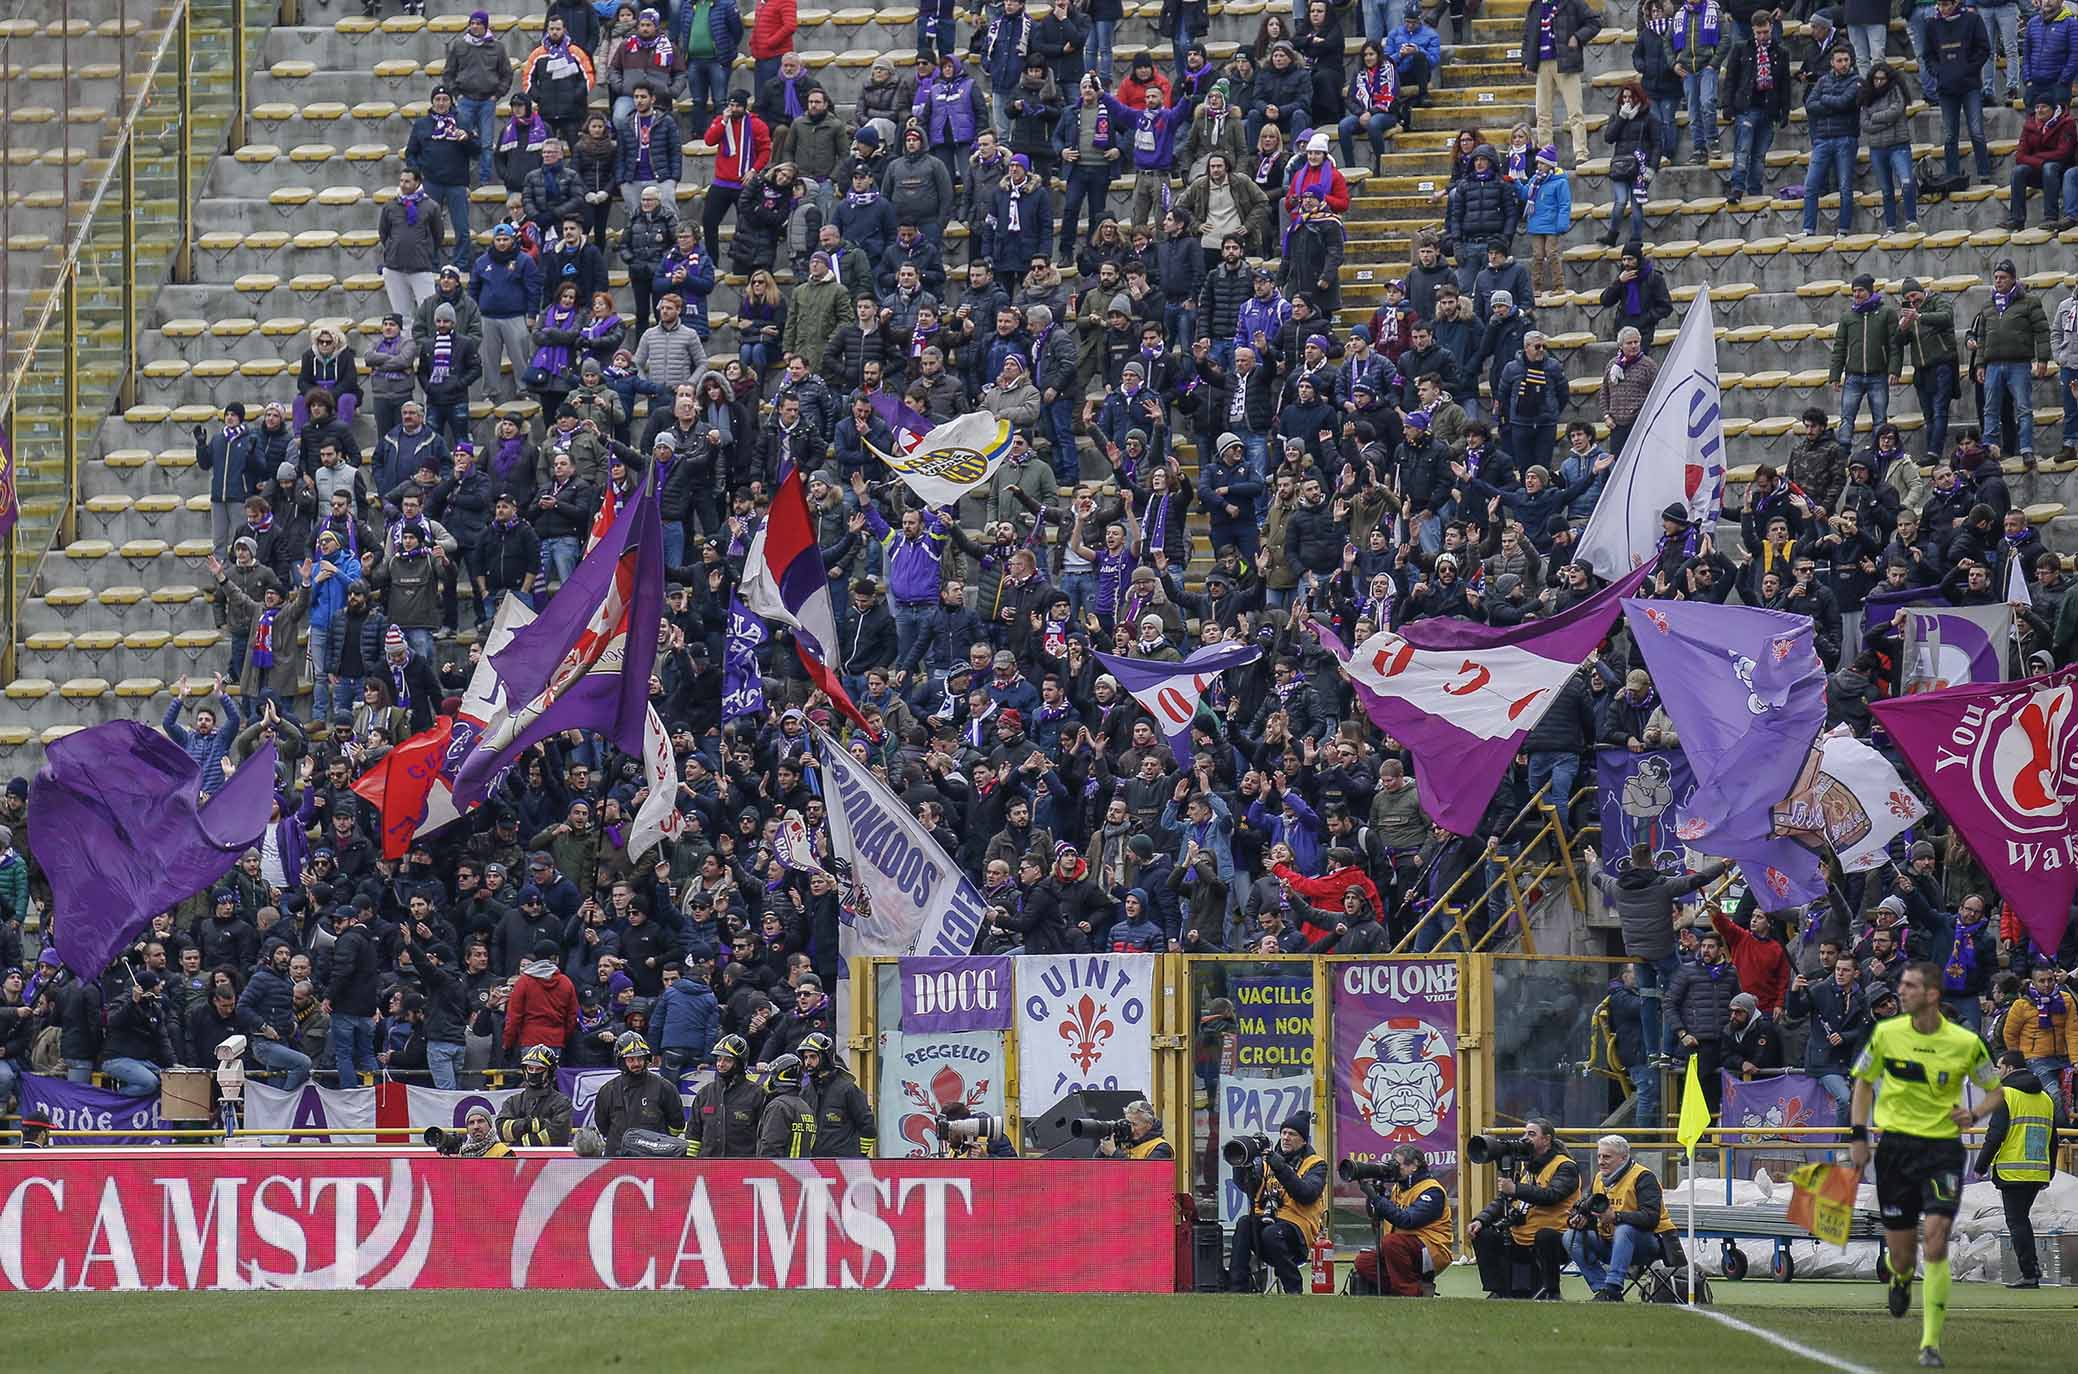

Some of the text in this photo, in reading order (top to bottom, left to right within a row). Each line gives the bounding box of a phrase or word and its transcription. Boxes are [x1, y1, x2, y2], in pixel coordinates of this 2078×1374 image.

[914, 969, 998, 1015] DOCG
[1026, 957, 1144, 1025] QUINTO
[1344, 963, 1456, 1003] CICLONE
[1239, 1016, 1313, 1035] MA NON
[905, 1044, 991, 1067] REGGELLO
[1239, 1046, 1313, 1064] CROLLO
[0, 1174, 385, 1290] CAMST
[587, 1174, 973, 1290] CAMST
